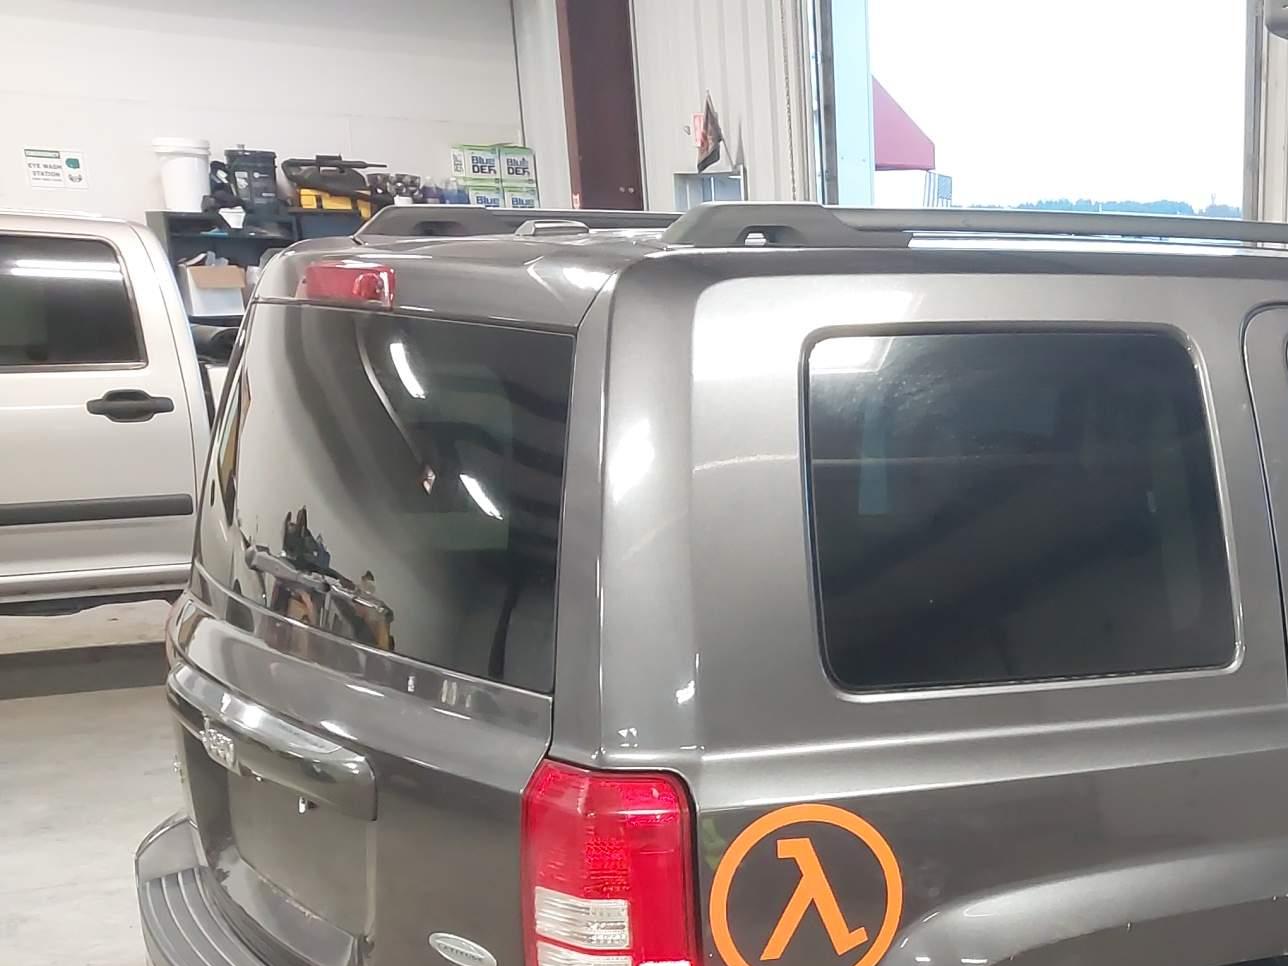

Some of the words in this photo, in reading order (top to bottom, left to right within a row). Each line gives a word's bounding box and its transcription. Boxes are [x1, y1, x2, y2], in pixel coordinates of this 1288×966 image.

[471, 155, 496, 165] Blue
[506, 157, 529, 167] Blue
[476, 195, 500, 205] Blue
[511, 197, 535, 206] Blue
